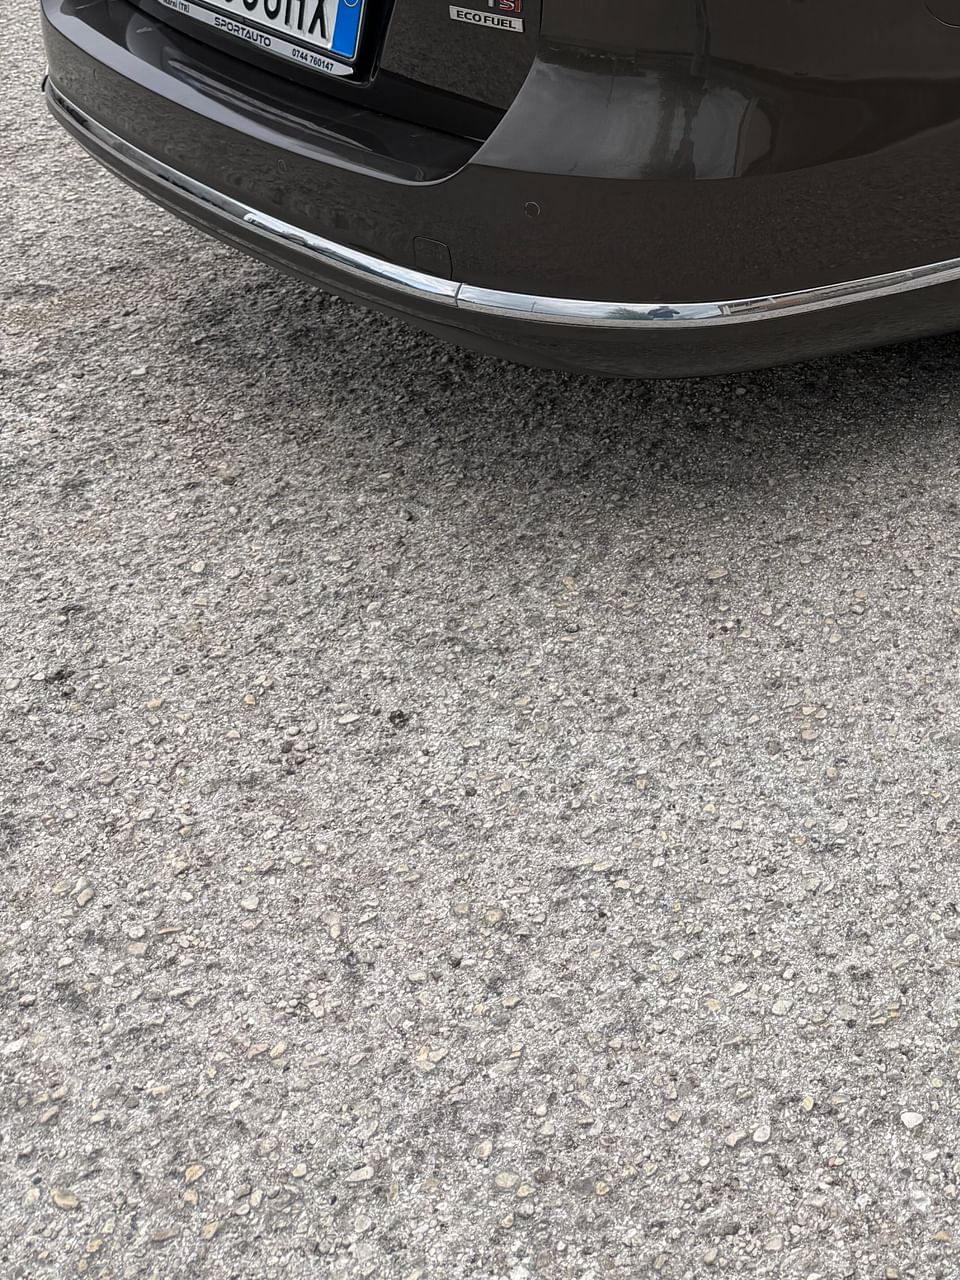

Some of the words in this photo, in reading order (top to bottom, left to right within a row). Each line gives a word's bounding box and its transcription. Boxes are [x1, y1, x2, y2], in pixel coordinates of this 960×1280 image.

[214, 16, 272, 47] SPORTAUTO
[292, 48, 308, 63] 0744
[309, 54, 334, 72] 760147
